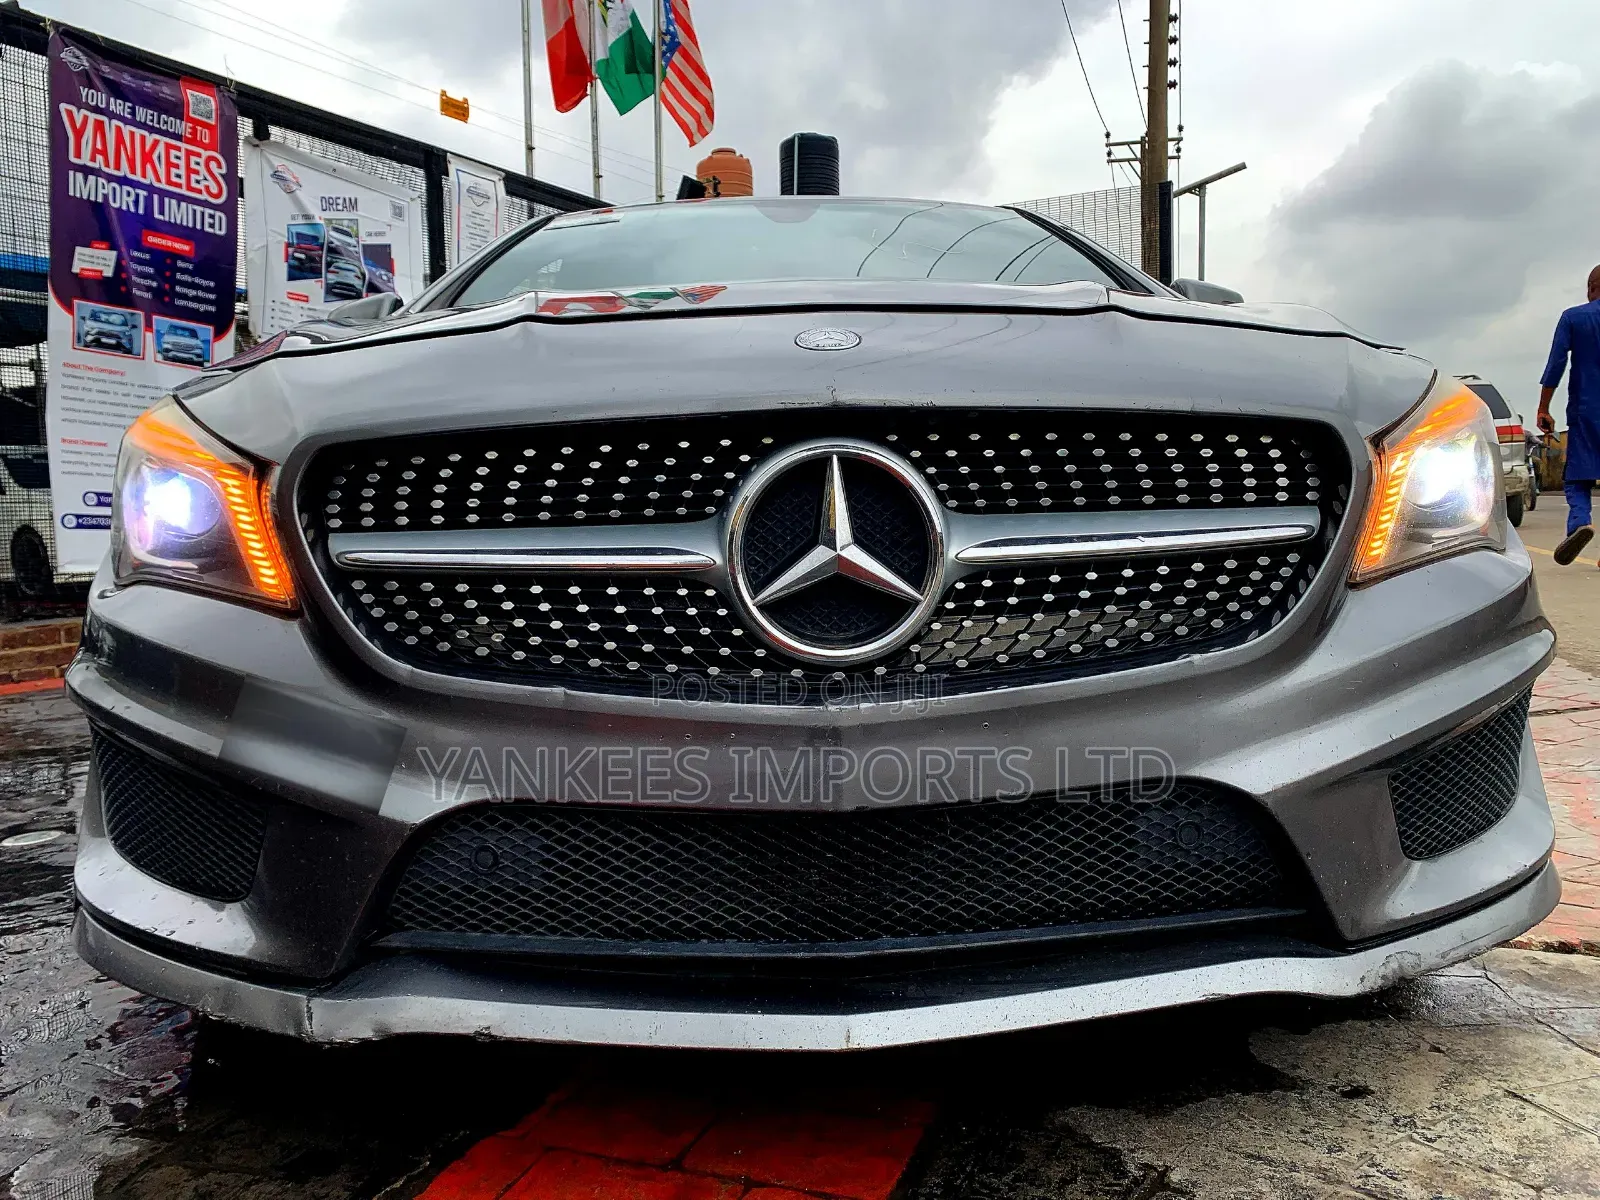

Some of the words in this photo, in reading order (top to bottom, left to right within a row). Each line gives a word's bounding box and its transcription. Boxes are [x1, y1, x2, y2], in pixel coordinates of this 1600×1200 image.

[79, 85, 107, 108] YOU
[109, 97, 133, 119] ARE
[135, 105, 193, 138] WELCOME
[195, 125, 211, 143] TO
[59, 102, 228, 204] YANKEES
[68, 170, 148, 215] IMPORT
[153, 194, 228, 236] LIMITED
[320, 195, 359, 213] DREAM
[147, 235, 172, 247] ORDER
[129, 249, 151, 259] Lexus
[129, 261, 155, 274] Toyota
[176, 260, 194, 270] Benz
[131, 275, 158, 288] Porsche
